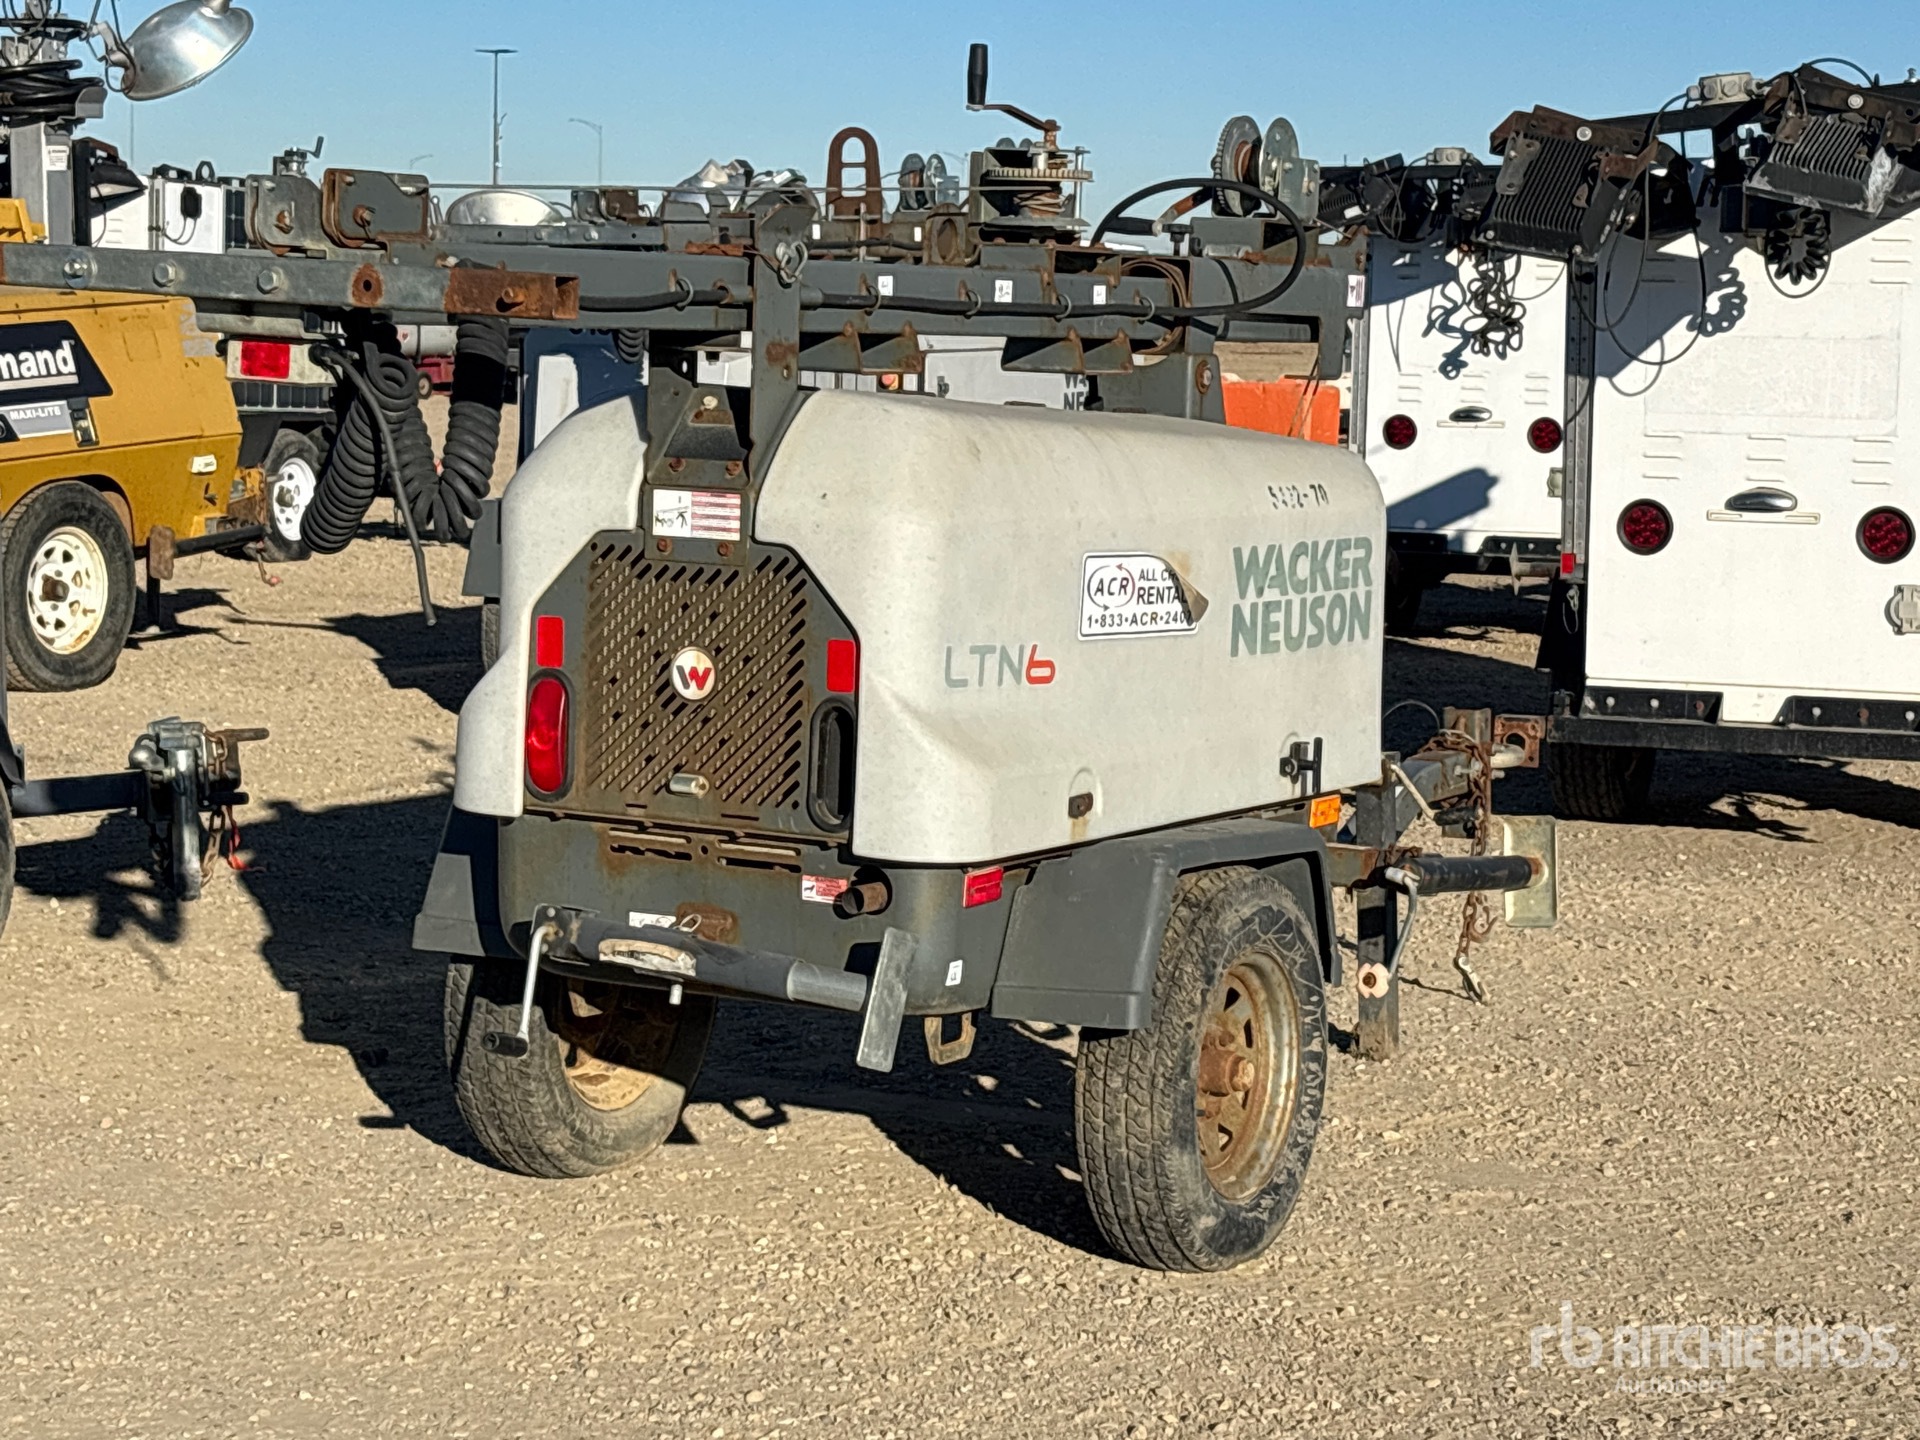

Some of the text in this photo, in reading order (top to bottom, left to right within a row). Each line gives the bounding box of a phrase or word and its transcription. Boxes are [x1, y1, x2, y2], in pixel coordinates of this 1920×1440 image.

[9, 406, 62, 421] MAXI-LITE
[1138, 568, 1158, 582] ALL
[1233, 537, 1373, 600] WACKER
[1094, 577, 1130, 597] ACR
[1230, 590, 1372, 658] NEUSON
[945, 644, 1056, 688] LTN6
